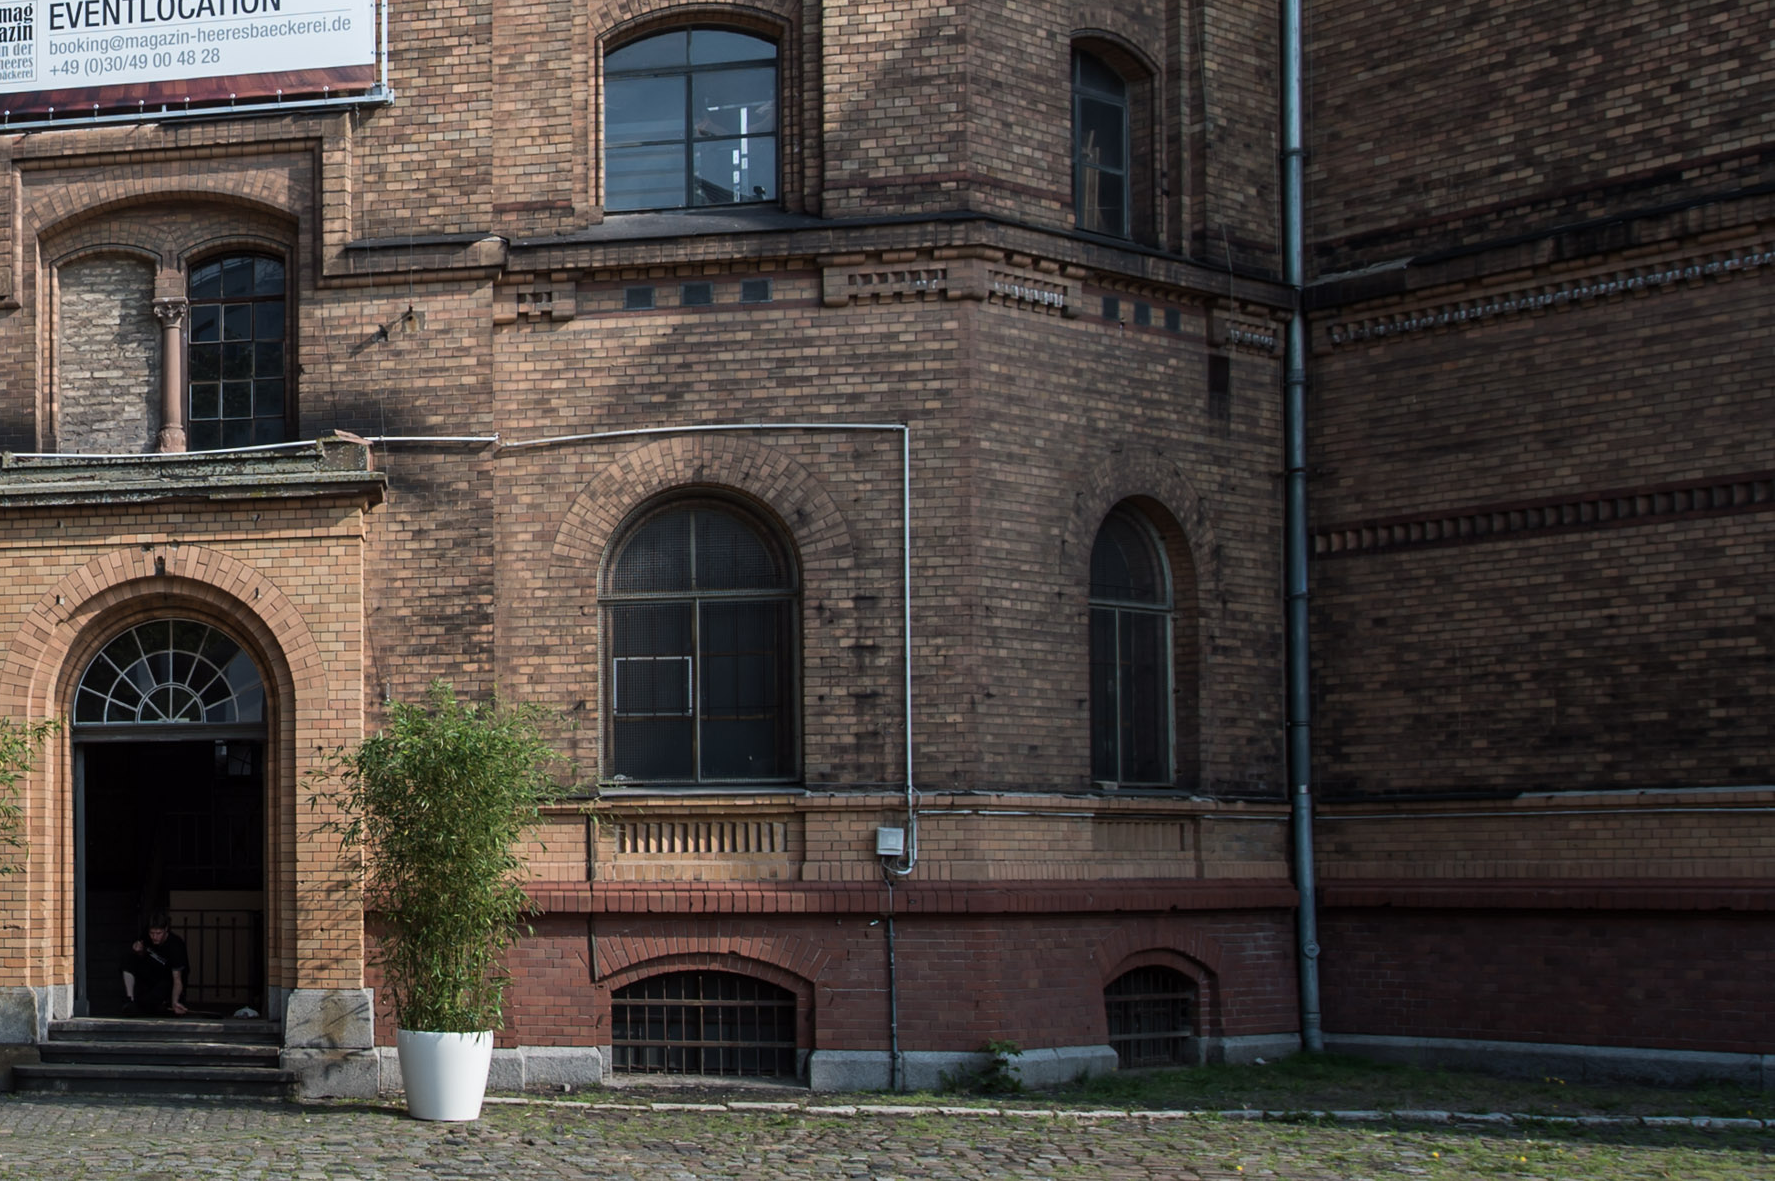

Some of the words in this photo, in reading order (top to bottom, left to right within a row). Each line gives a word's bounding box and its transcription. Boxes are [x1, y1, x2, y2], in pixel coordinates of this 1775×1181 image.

[12, 42, 33, 57] der
[49, 15, 352, 55] booking@magazin-heeresbaeckerei.de
[49, 59, 80, 76] +49
[84, 53, 148, 77] (0)30/49
[152, 51, 172, 68] 00
[176, 49, 196, 66] 48
[200, 47, 221, 64] 28
